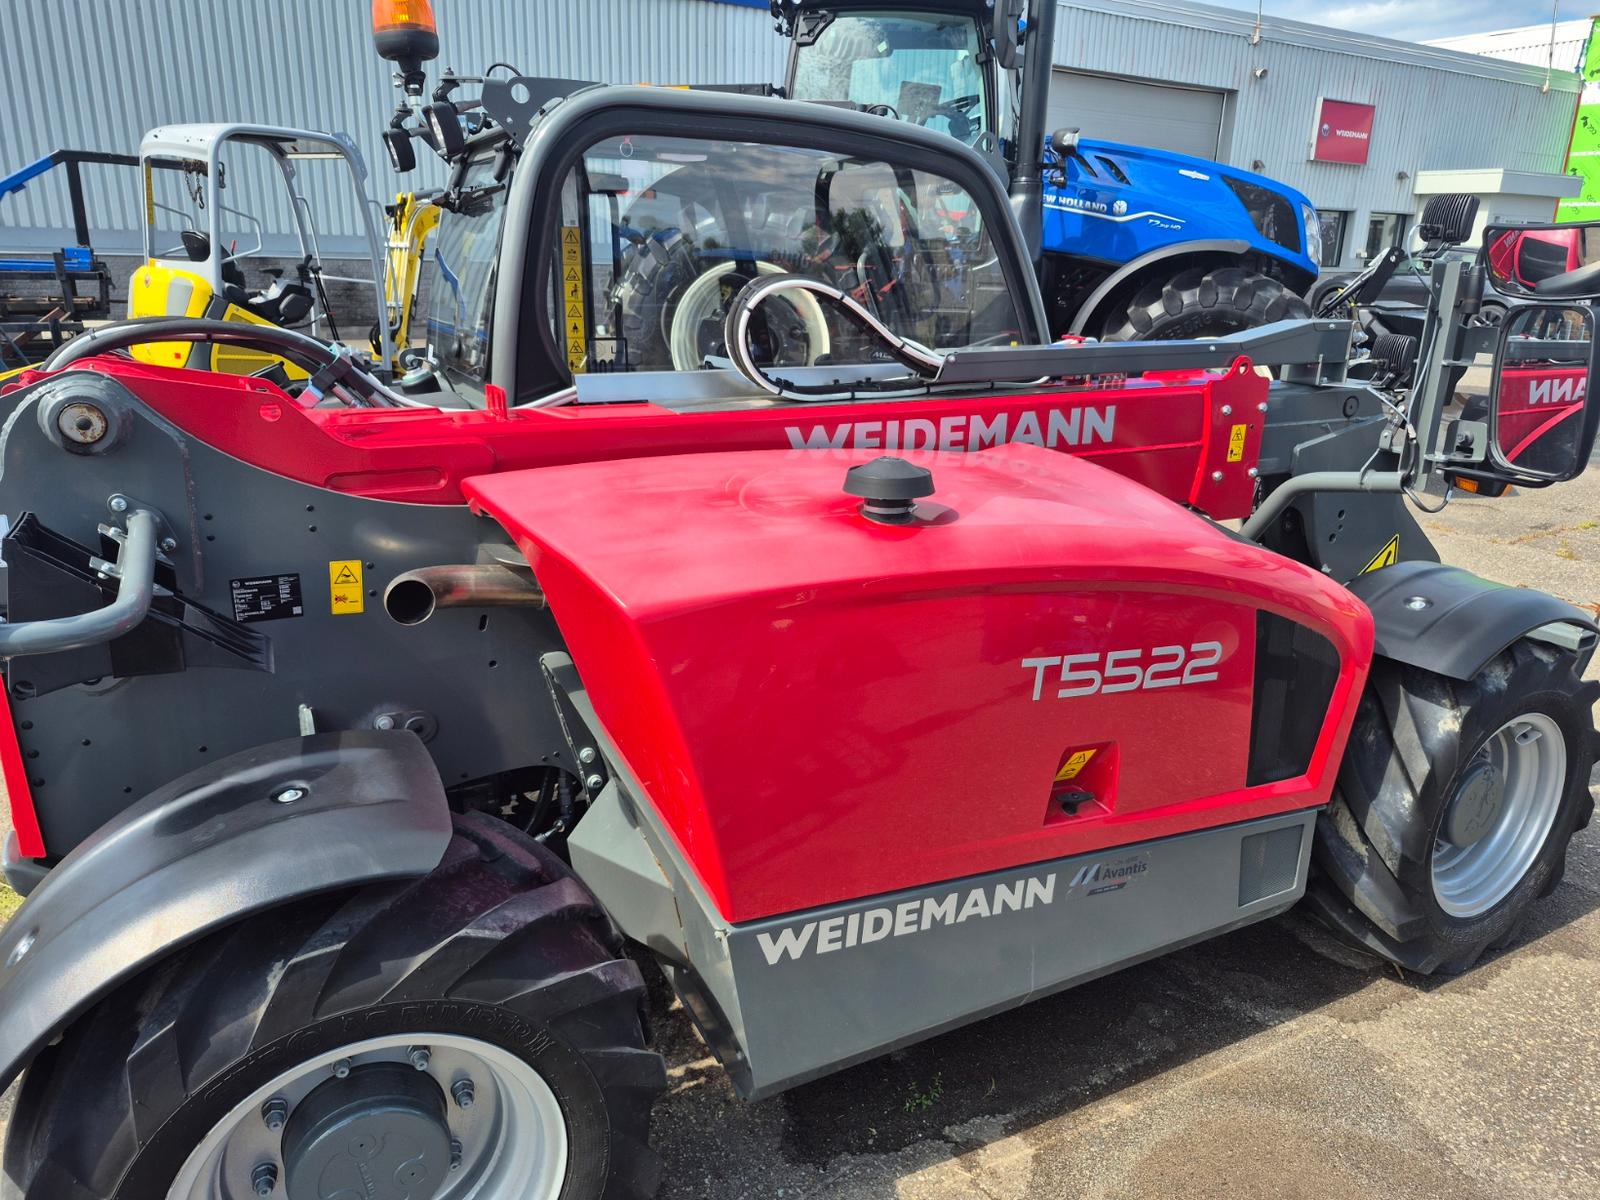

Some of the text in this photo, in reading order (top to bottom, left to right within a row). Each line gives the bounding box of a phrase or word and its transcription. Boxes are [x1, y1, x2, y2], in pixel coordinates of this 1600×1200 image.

[1058, 196, 1107, 213] HOLLAND
[785, 405, 1116, 451] WEIDEMANN
[1021, 640, 1223, 701] T5522
[1102, 860, 1148, 881] Avantis
[756, 873, 1057, 966] WEIDEMANN
